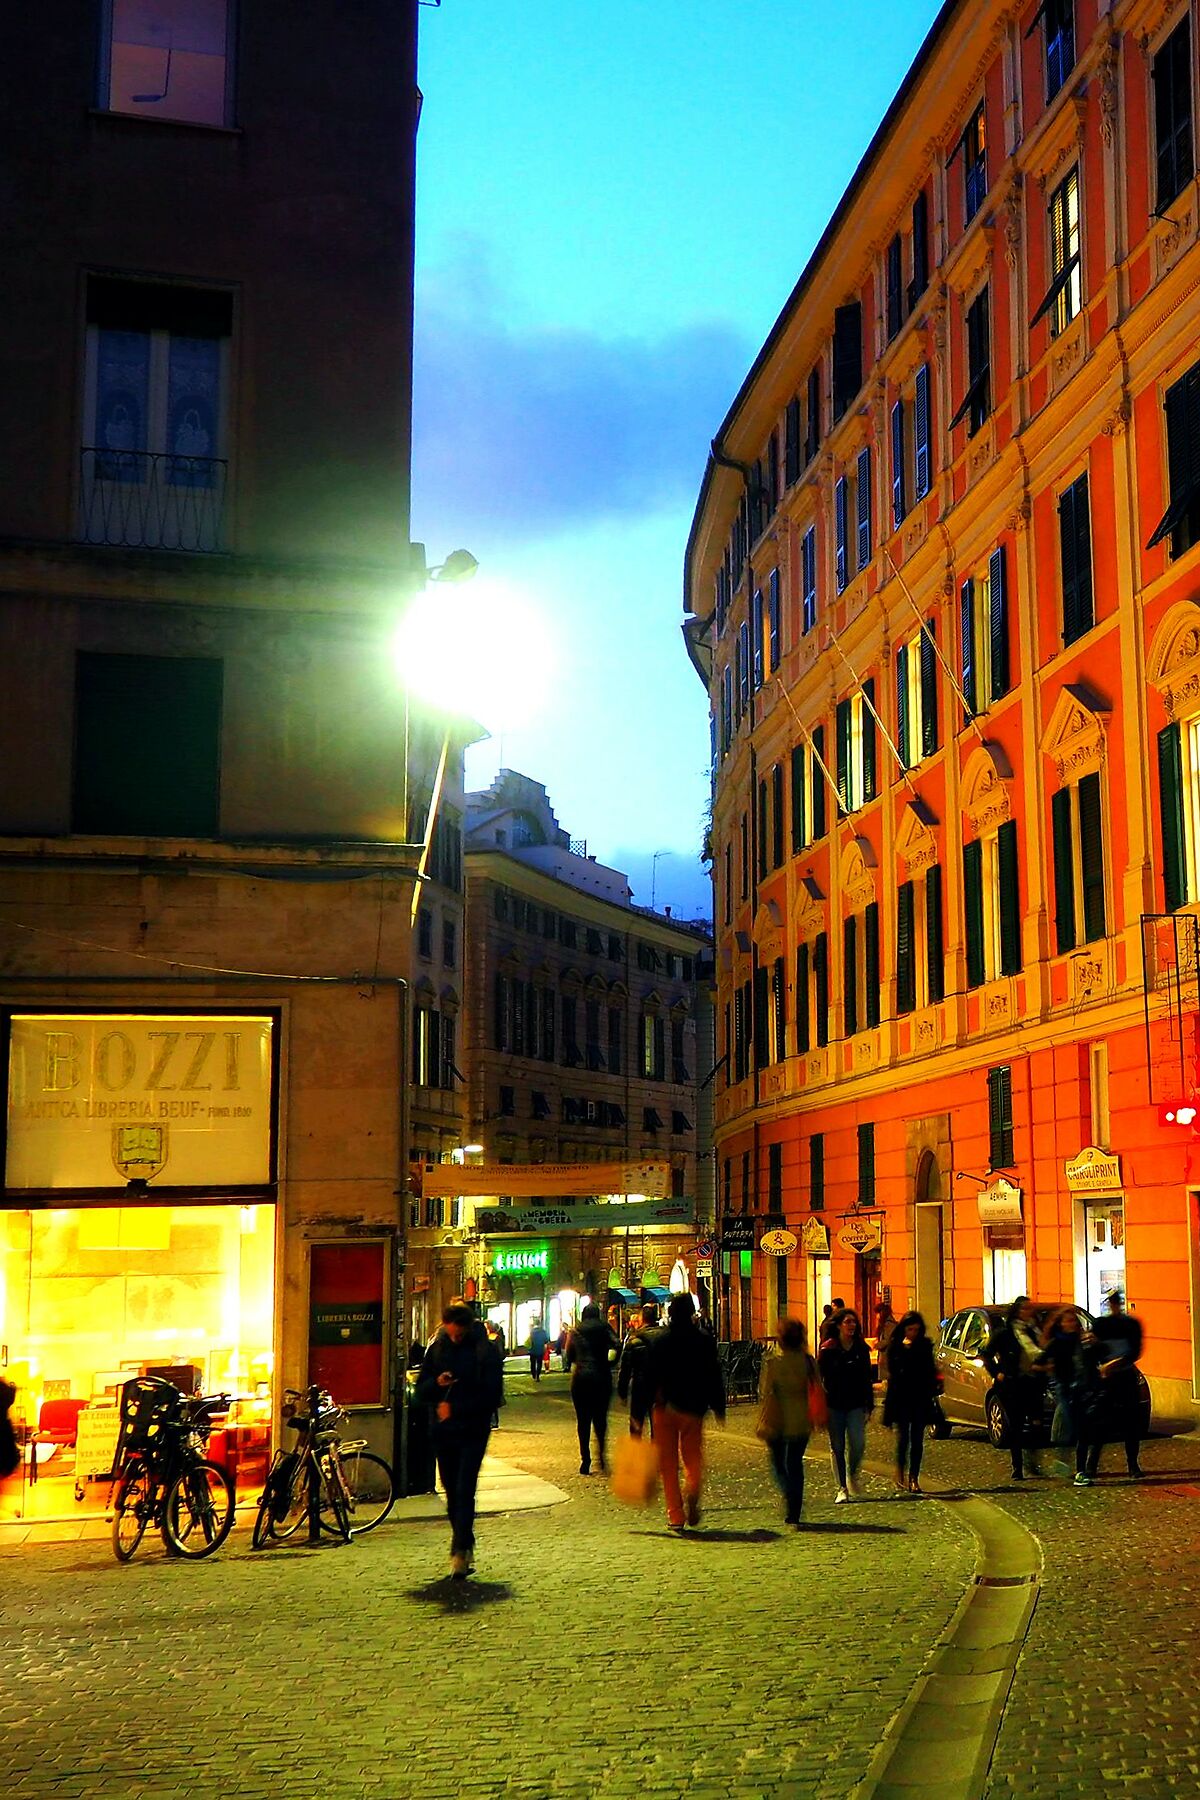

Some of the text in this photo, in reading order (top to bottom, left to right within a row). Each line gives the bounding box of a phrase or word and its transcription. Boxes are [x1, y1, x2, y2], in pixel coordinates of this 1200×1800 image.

[42, 1031, 242, 1092] BOZZI
[24, 1101, 80, 1119] ANTICA
[85, 1101, 152, 1118] LIBRERIA
[527, 1209, 566, 1218] MEMORIA
[538, 1217, 572, 1225] GUERRA
[352, 1313, 374, 1321] BOZZI
